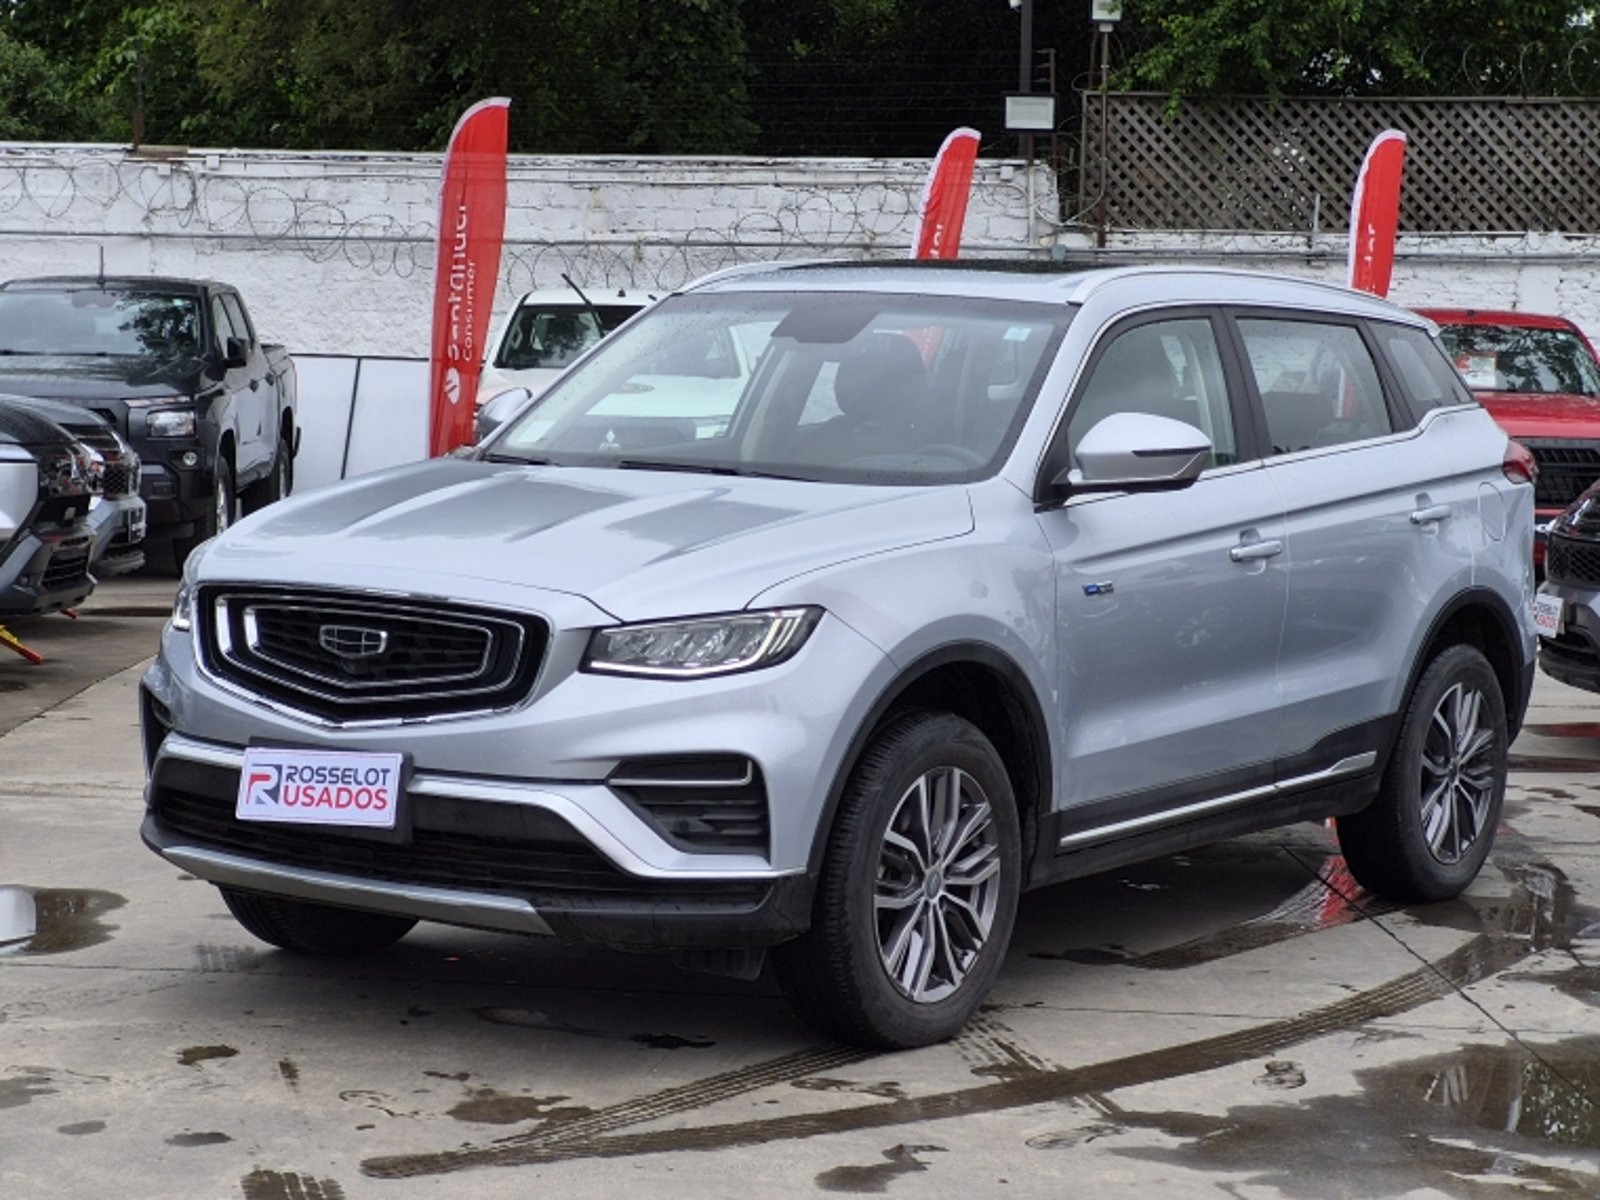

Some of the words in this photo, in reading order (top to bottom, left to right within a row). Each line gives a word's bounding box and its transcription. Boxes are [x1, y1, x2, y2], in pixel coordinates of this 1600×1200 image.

[463, 262, 476, 361] Consumer
[285, 765, 390, 786] ROSSELOT
[283, 786, 388, 810] USADOS
